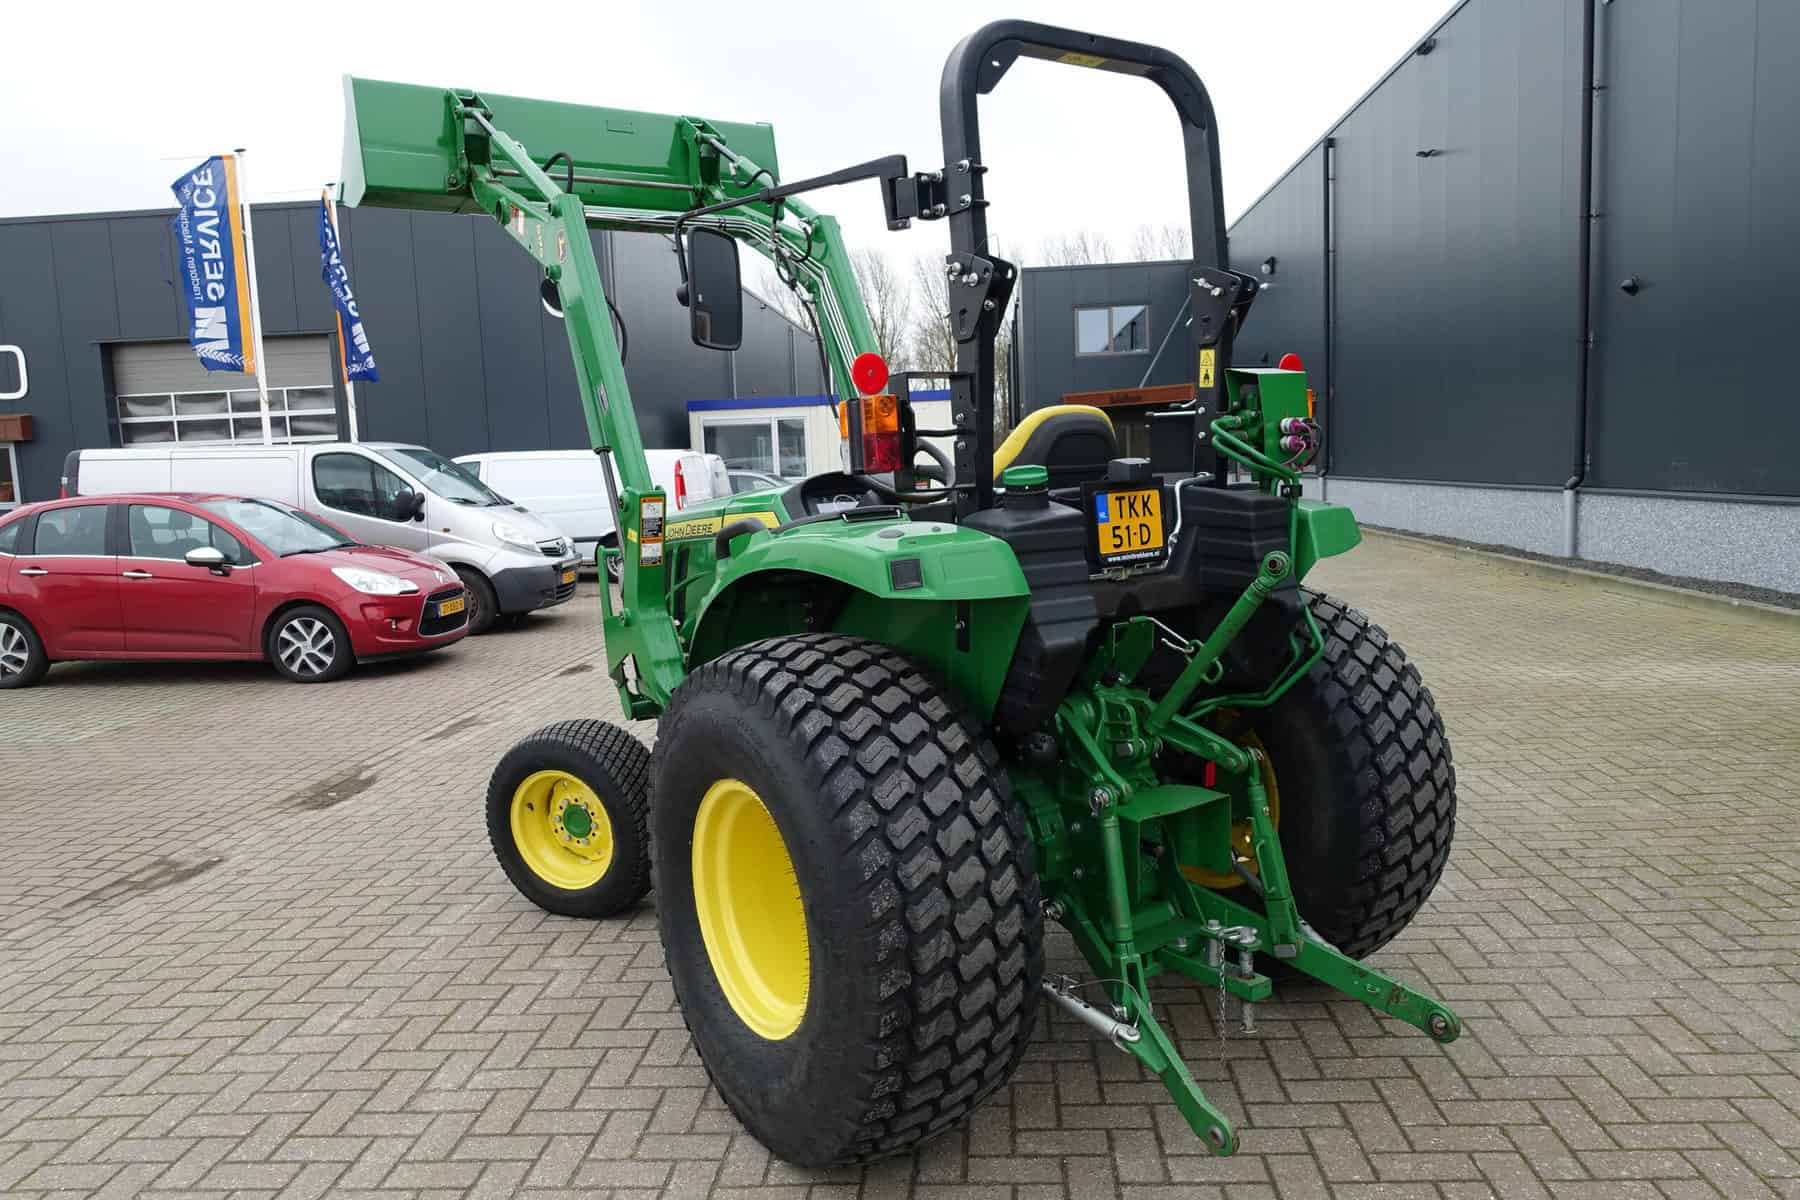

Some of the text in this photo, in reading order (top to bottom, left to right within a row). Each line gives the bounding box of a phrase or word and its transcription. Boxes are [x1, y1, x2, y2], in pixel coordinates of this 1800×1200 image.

[1115, 494, 1153, 519] TKK
[686, 523, 713, 536] DEERE
[1112, 523, 1151, 549] 51-D
